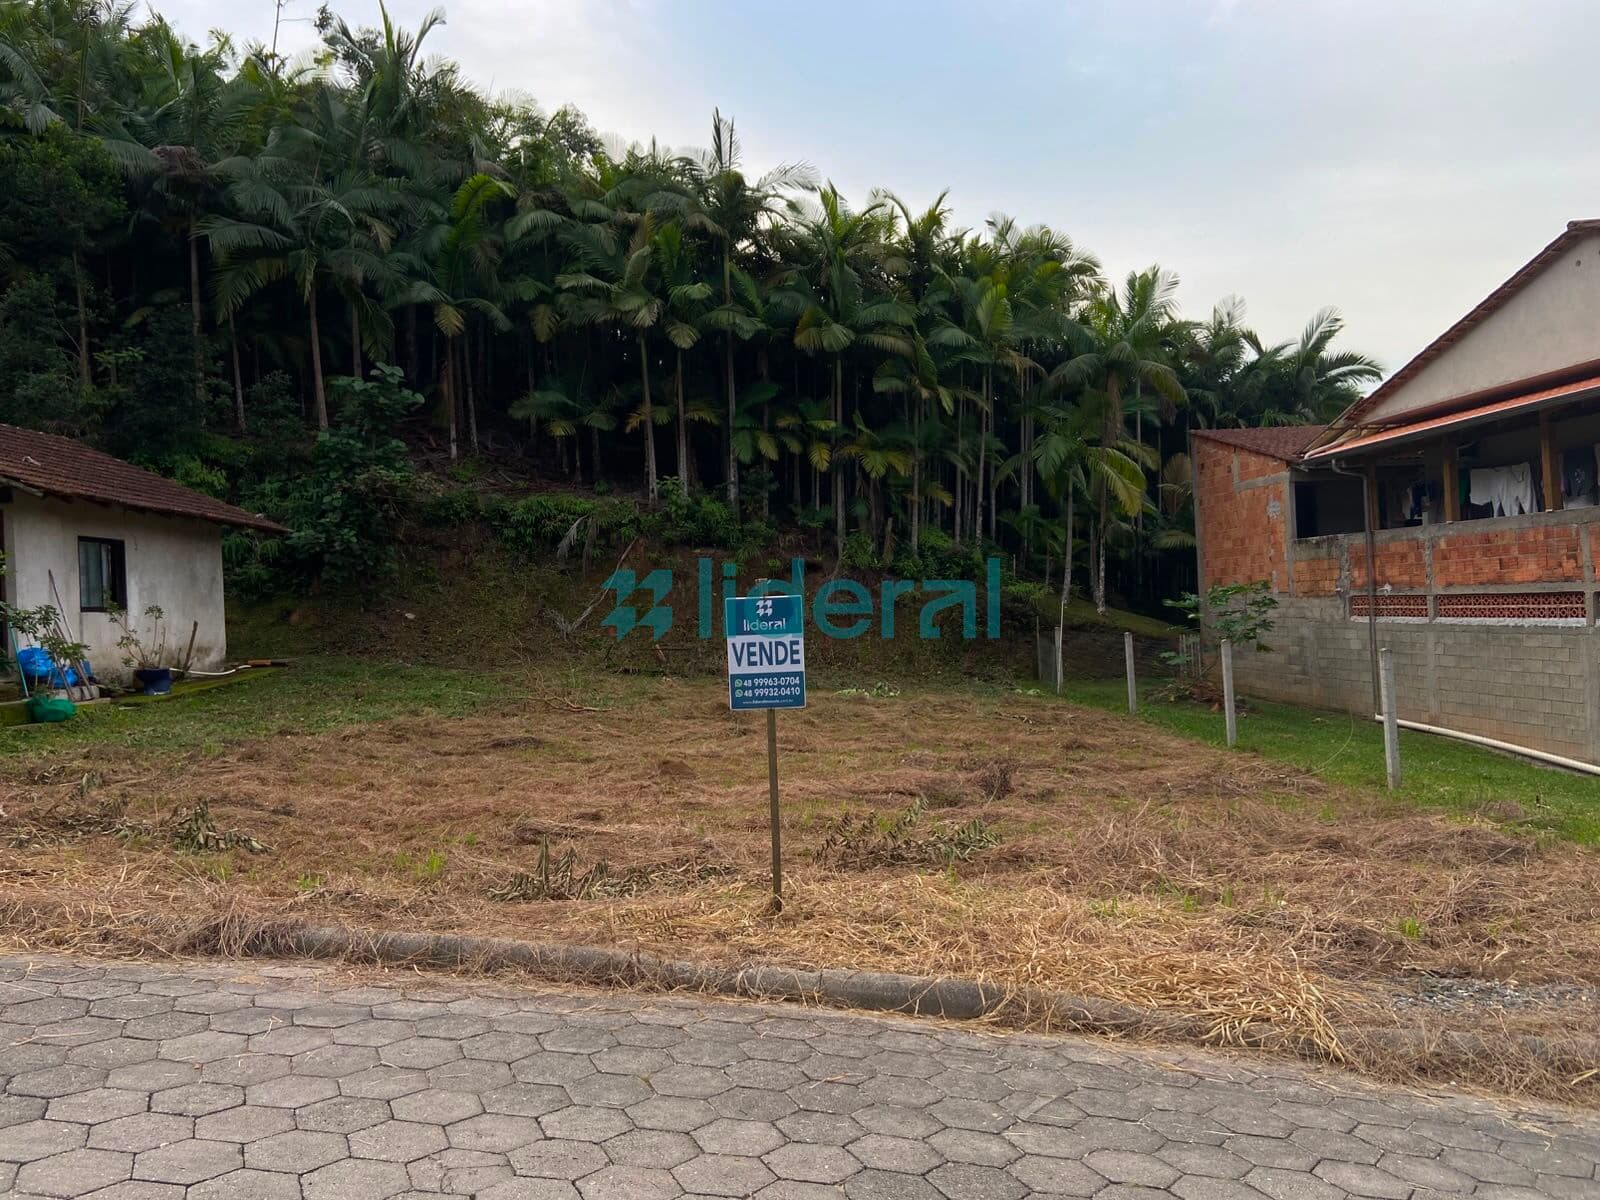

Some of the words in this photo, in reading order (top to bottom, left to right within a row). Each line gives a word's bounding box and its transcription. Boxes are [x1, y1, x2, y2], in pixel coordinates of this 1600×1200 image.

[743, 617, 785, 631] lideral
[731, 639, 800, 667] VENDE
[753, 676, 800, 687] 99963-0704
